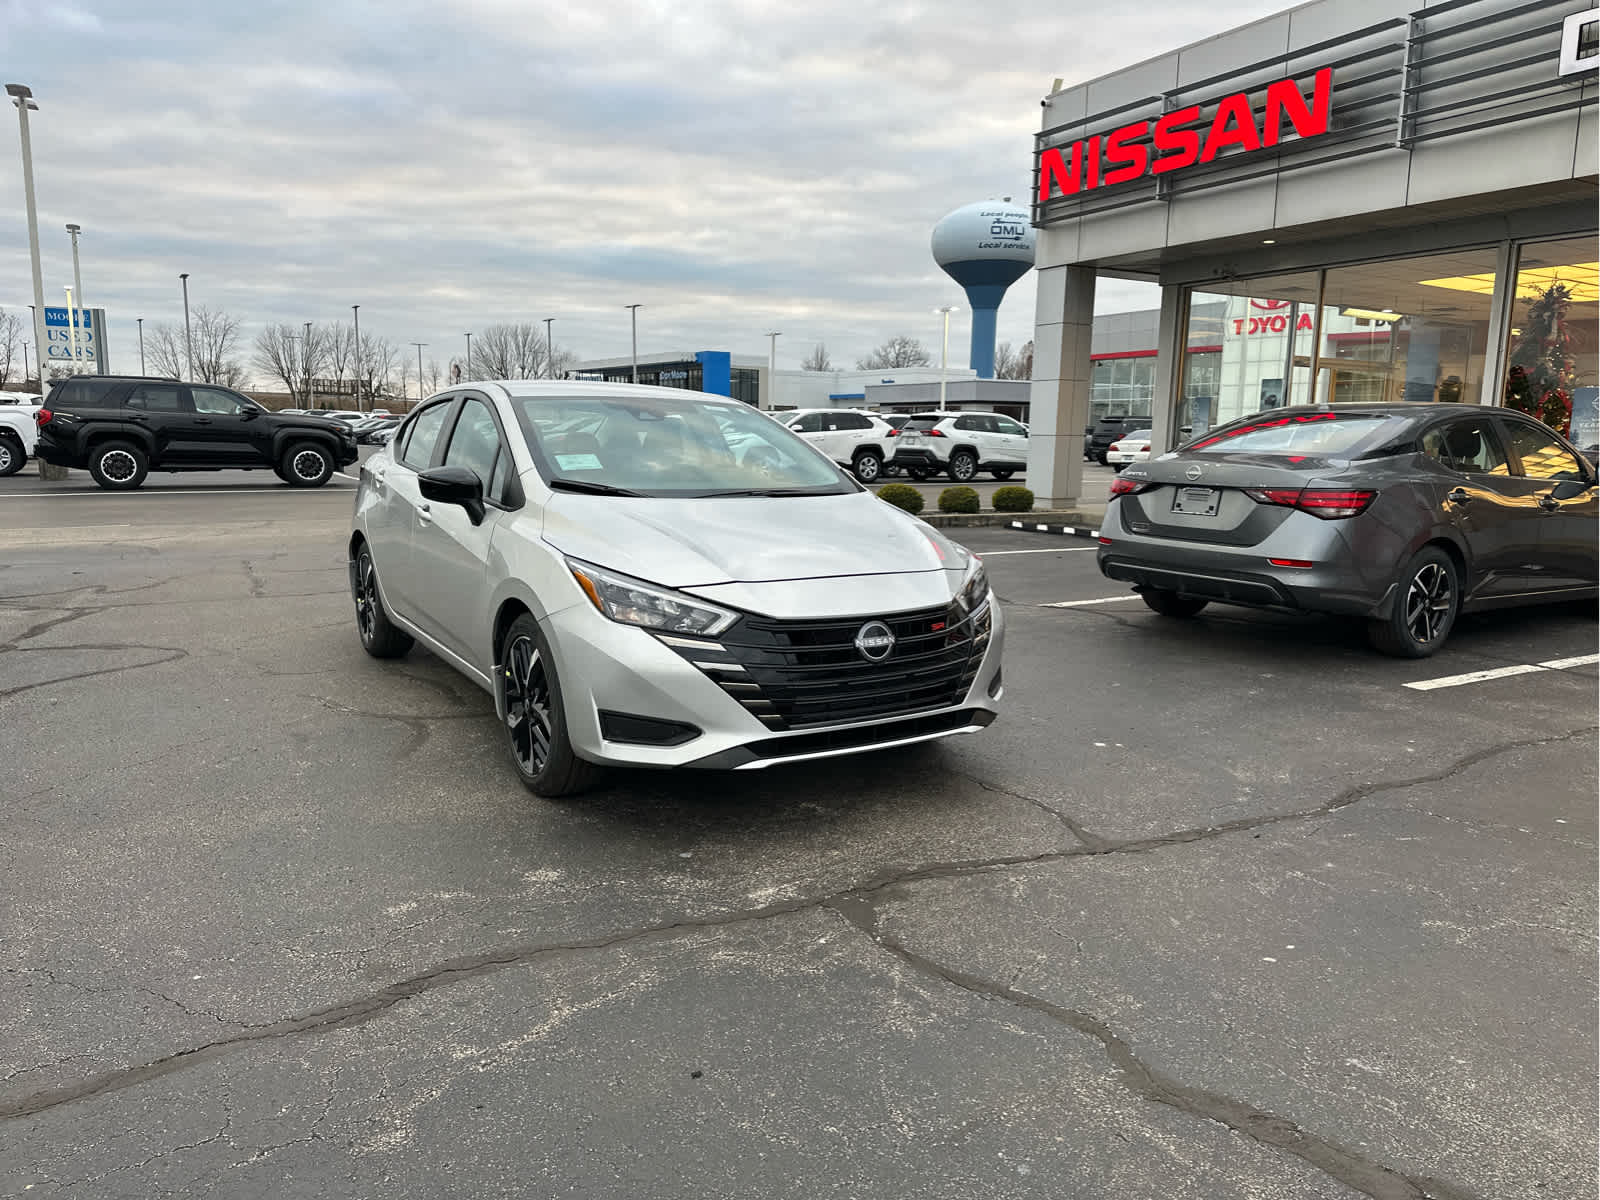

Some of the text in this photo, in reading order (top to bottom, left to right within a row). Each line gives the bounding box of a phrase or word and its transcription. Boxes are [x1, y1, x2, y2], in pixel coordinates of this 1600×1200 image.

[1039, 67, 1332, 201] NISSAN
[47, 311, 89, 323] MOE
[1233, 313, 1313, 336] TOYOA
[47, 344, 94, 357] CARS
[854, 635, 895, 648] NISSAN
